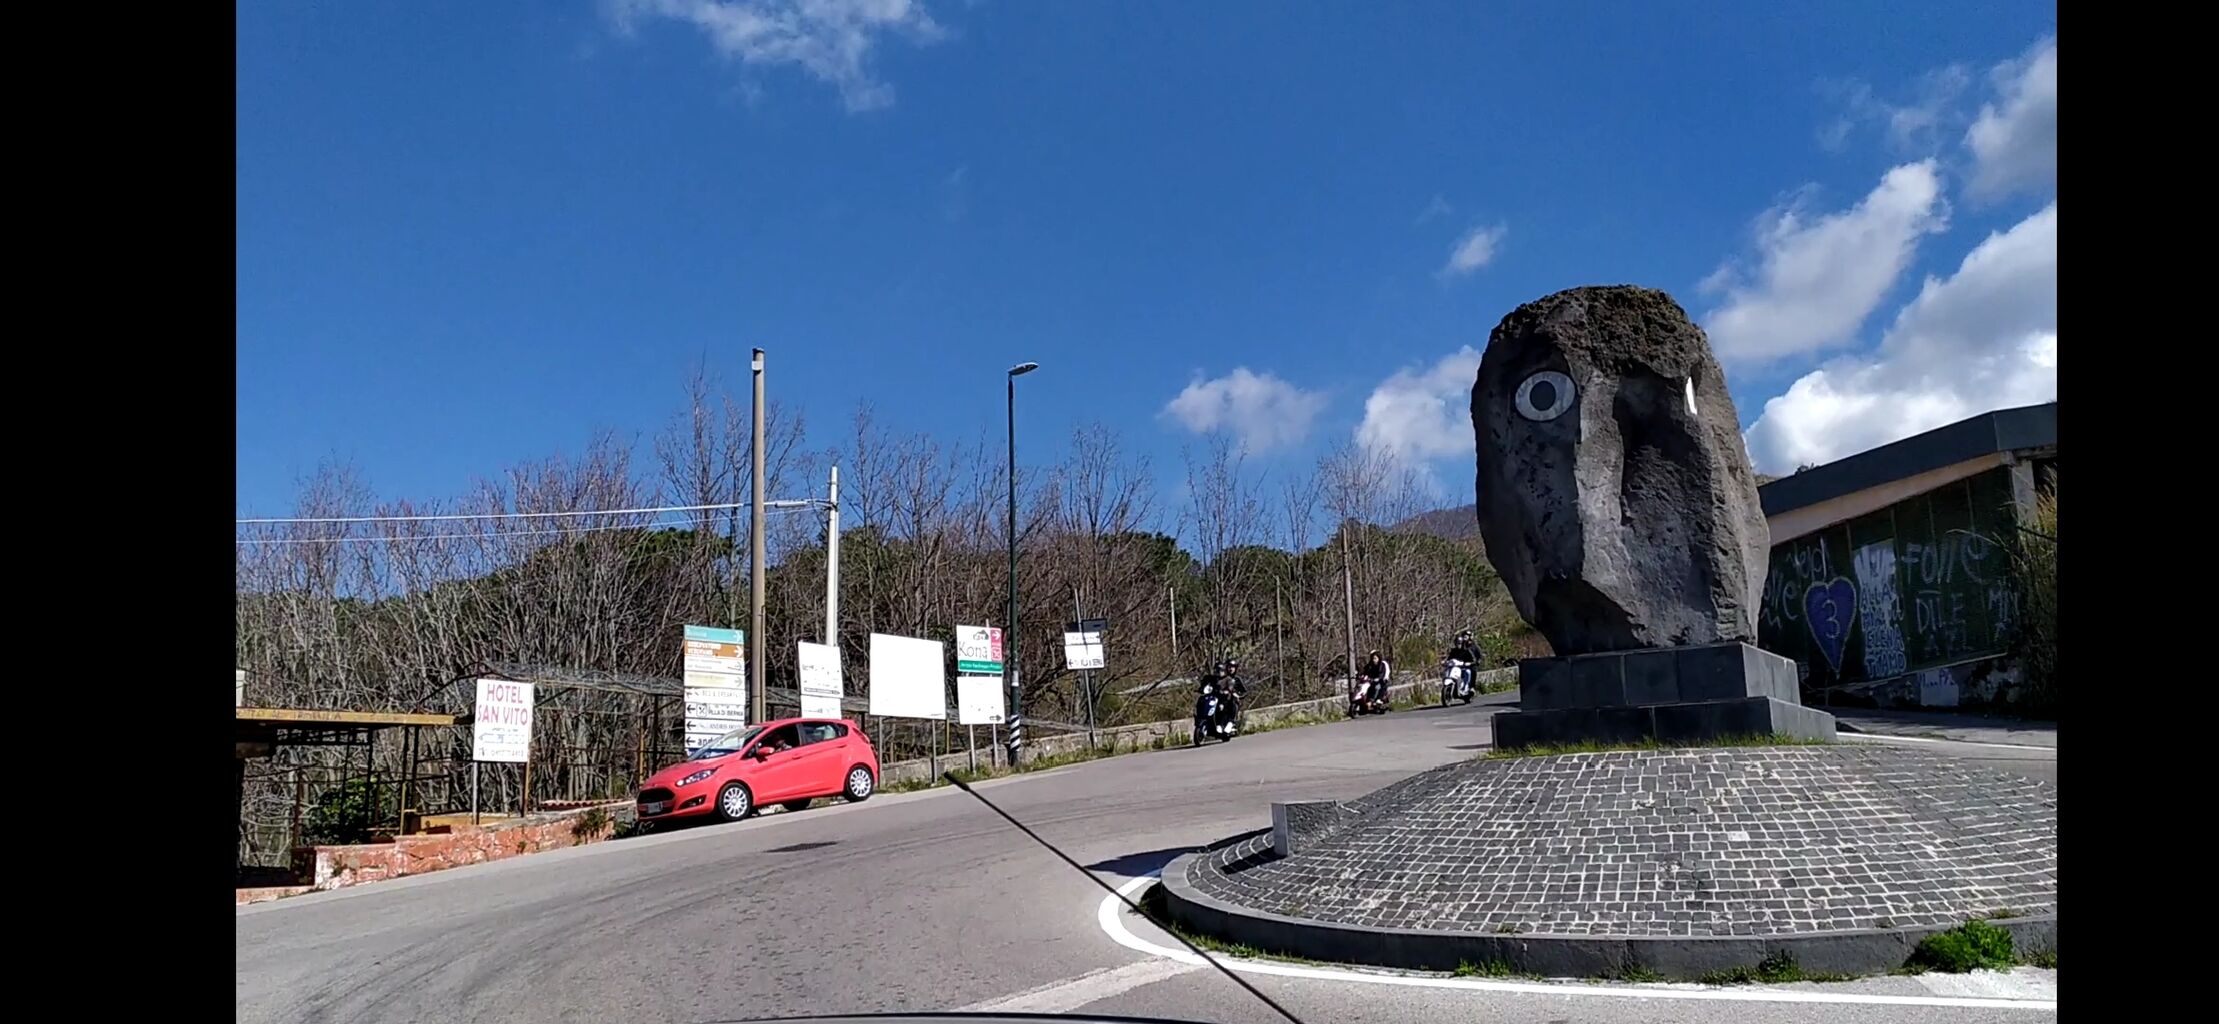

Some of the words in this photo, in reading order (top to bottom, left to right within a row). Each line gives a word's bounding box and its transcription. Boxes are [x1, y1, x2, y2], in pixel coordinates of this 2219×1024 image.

[1822, 599, 1841, 639] 3
[958, 641, 988, 660] Kona
[486, 683, 524, 704] HOTEL
[477, 704, 500, 724] SAN
[502, 706, 529, 727] VITO
